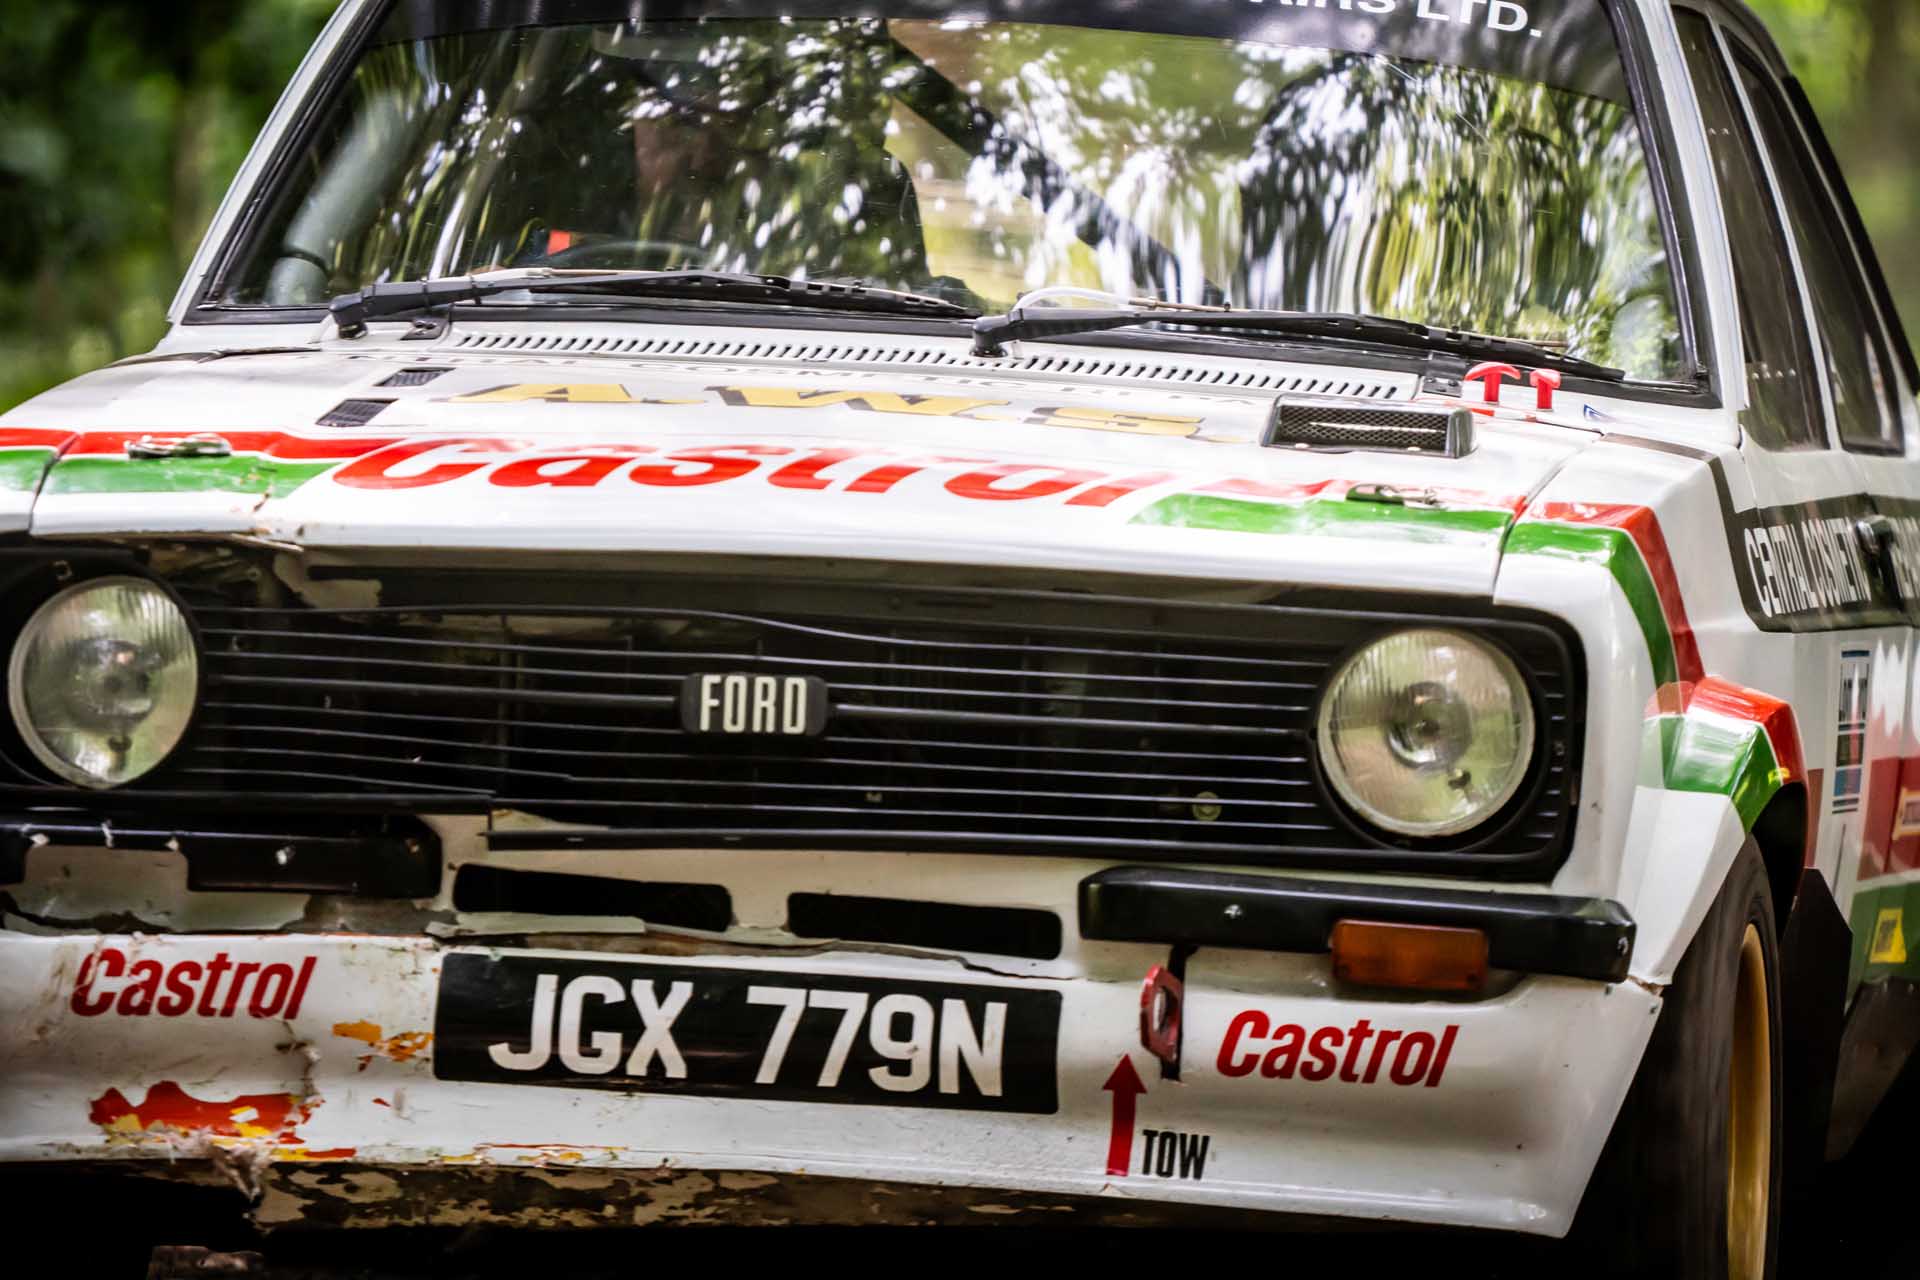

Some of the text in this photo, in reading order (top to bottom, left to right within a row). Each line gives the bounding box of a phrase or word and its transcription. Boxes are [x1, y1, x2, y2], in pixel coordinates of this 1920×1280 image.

[1416, 0, 1542, 38] LTD.
[333, 437, 1175, 507] Castrol
[700, 674, 807, 734] FORD
[70, 948, 318, 1020] Castrol
[488, 974, 1008, 1097] JGX 779N
[1216, 1010, 1460, 1088] Castrol
[1142, 1129, 1210, 1180] TOW
